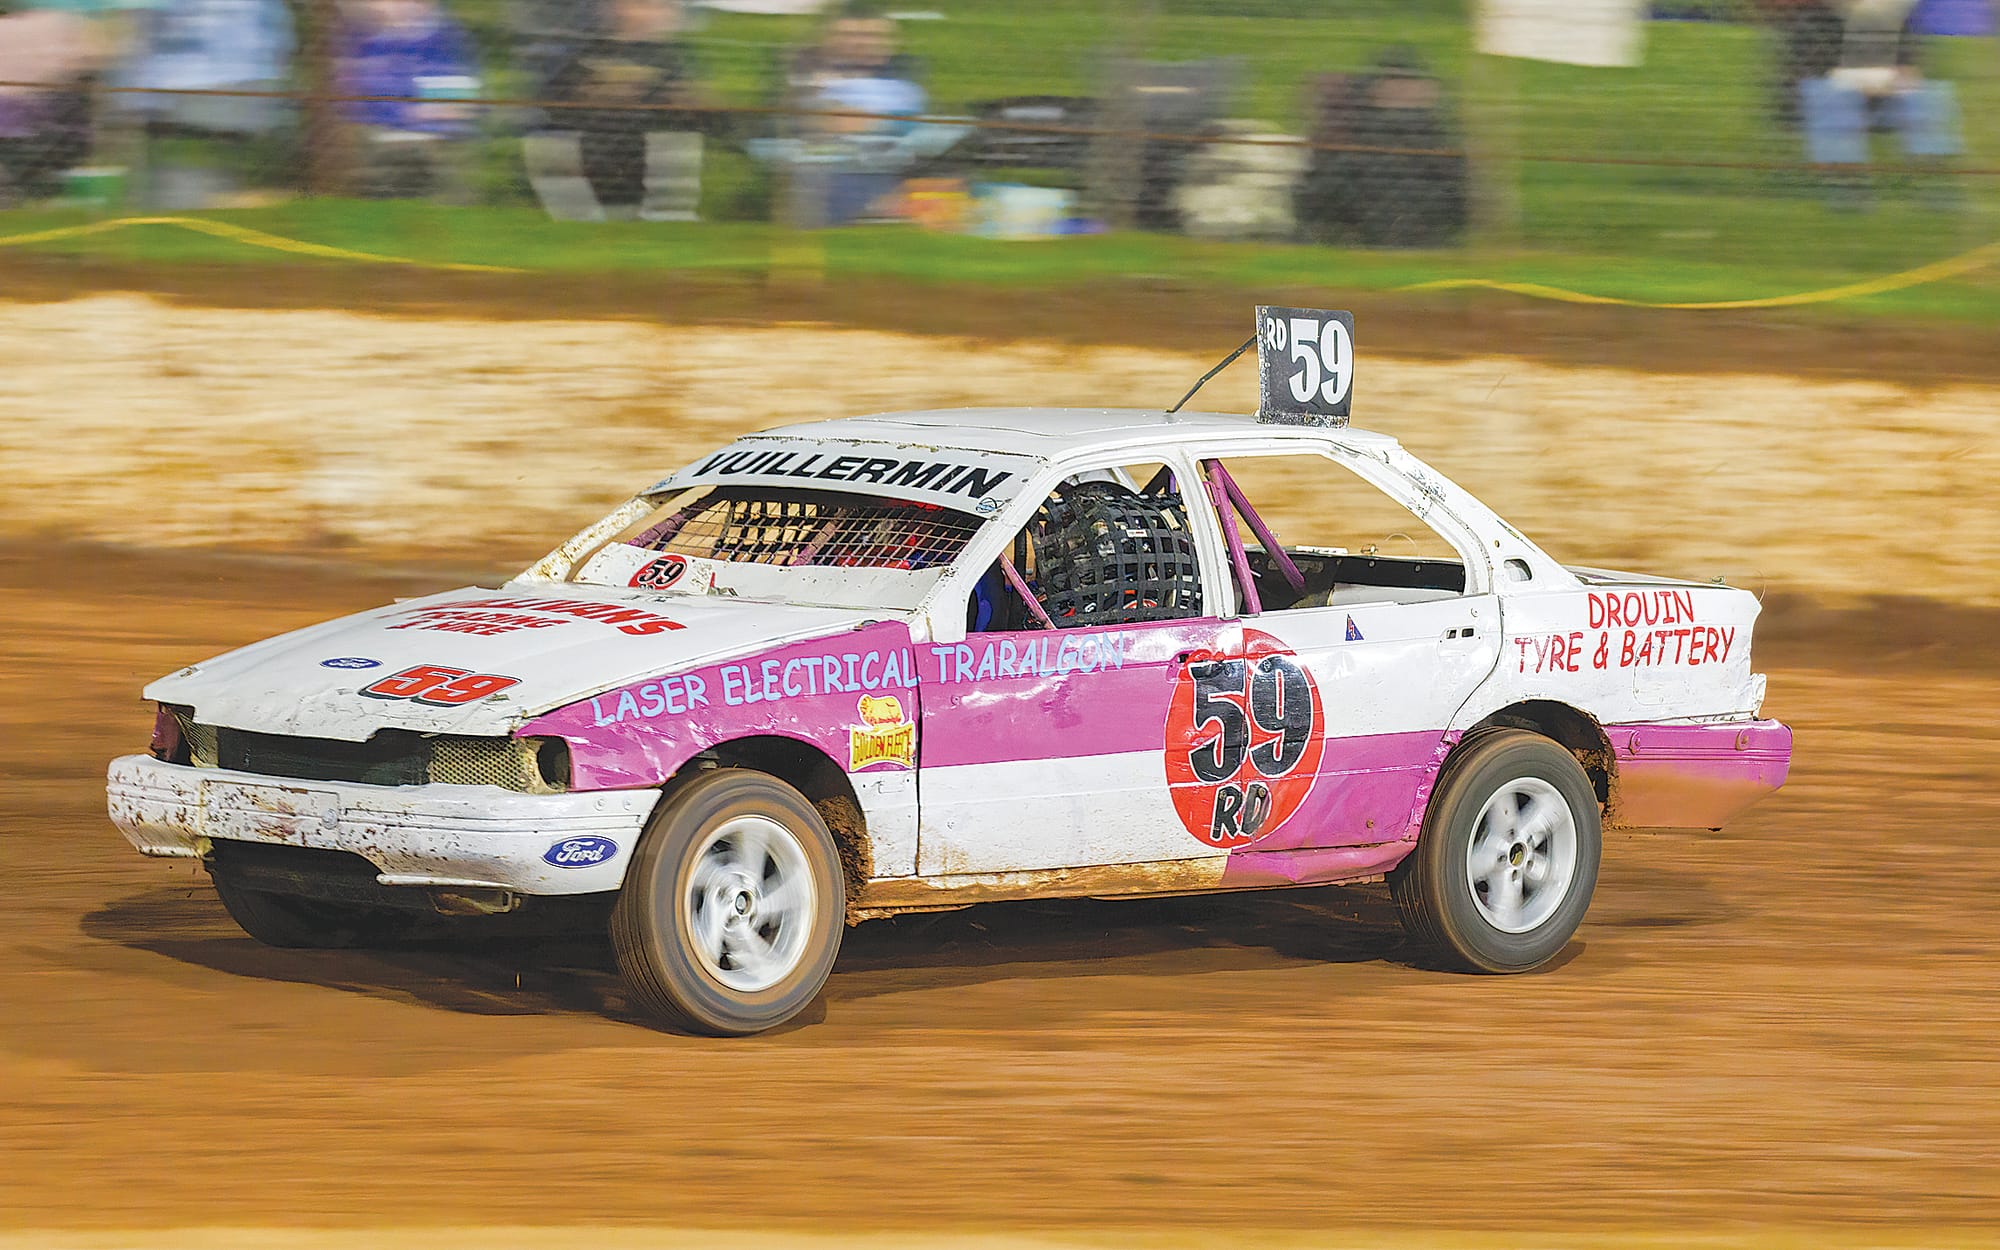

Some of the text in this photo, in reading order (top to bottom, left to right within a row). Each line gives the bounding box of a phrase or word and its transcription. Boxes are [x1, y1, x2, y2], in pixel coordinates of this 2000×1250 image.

[1265, 317, 1353, 405] RD 59
[692, 451, 1013, 499] VUILLERMIN
[638, 559, 685, 586] 59
[1587, 590, 1695, 629] DROUIN
[1514, 626, 1735, 674] TYRE & BATTERY
[360, 663, 523, 708] 59
[591, 631, 1124, 727] LASER ELECTRICAL TRARALGON
[1187, 655, 1314, 783] 59
[1211, 781, 1272, 842] RD
[555, 840, 607, 863] Ford
